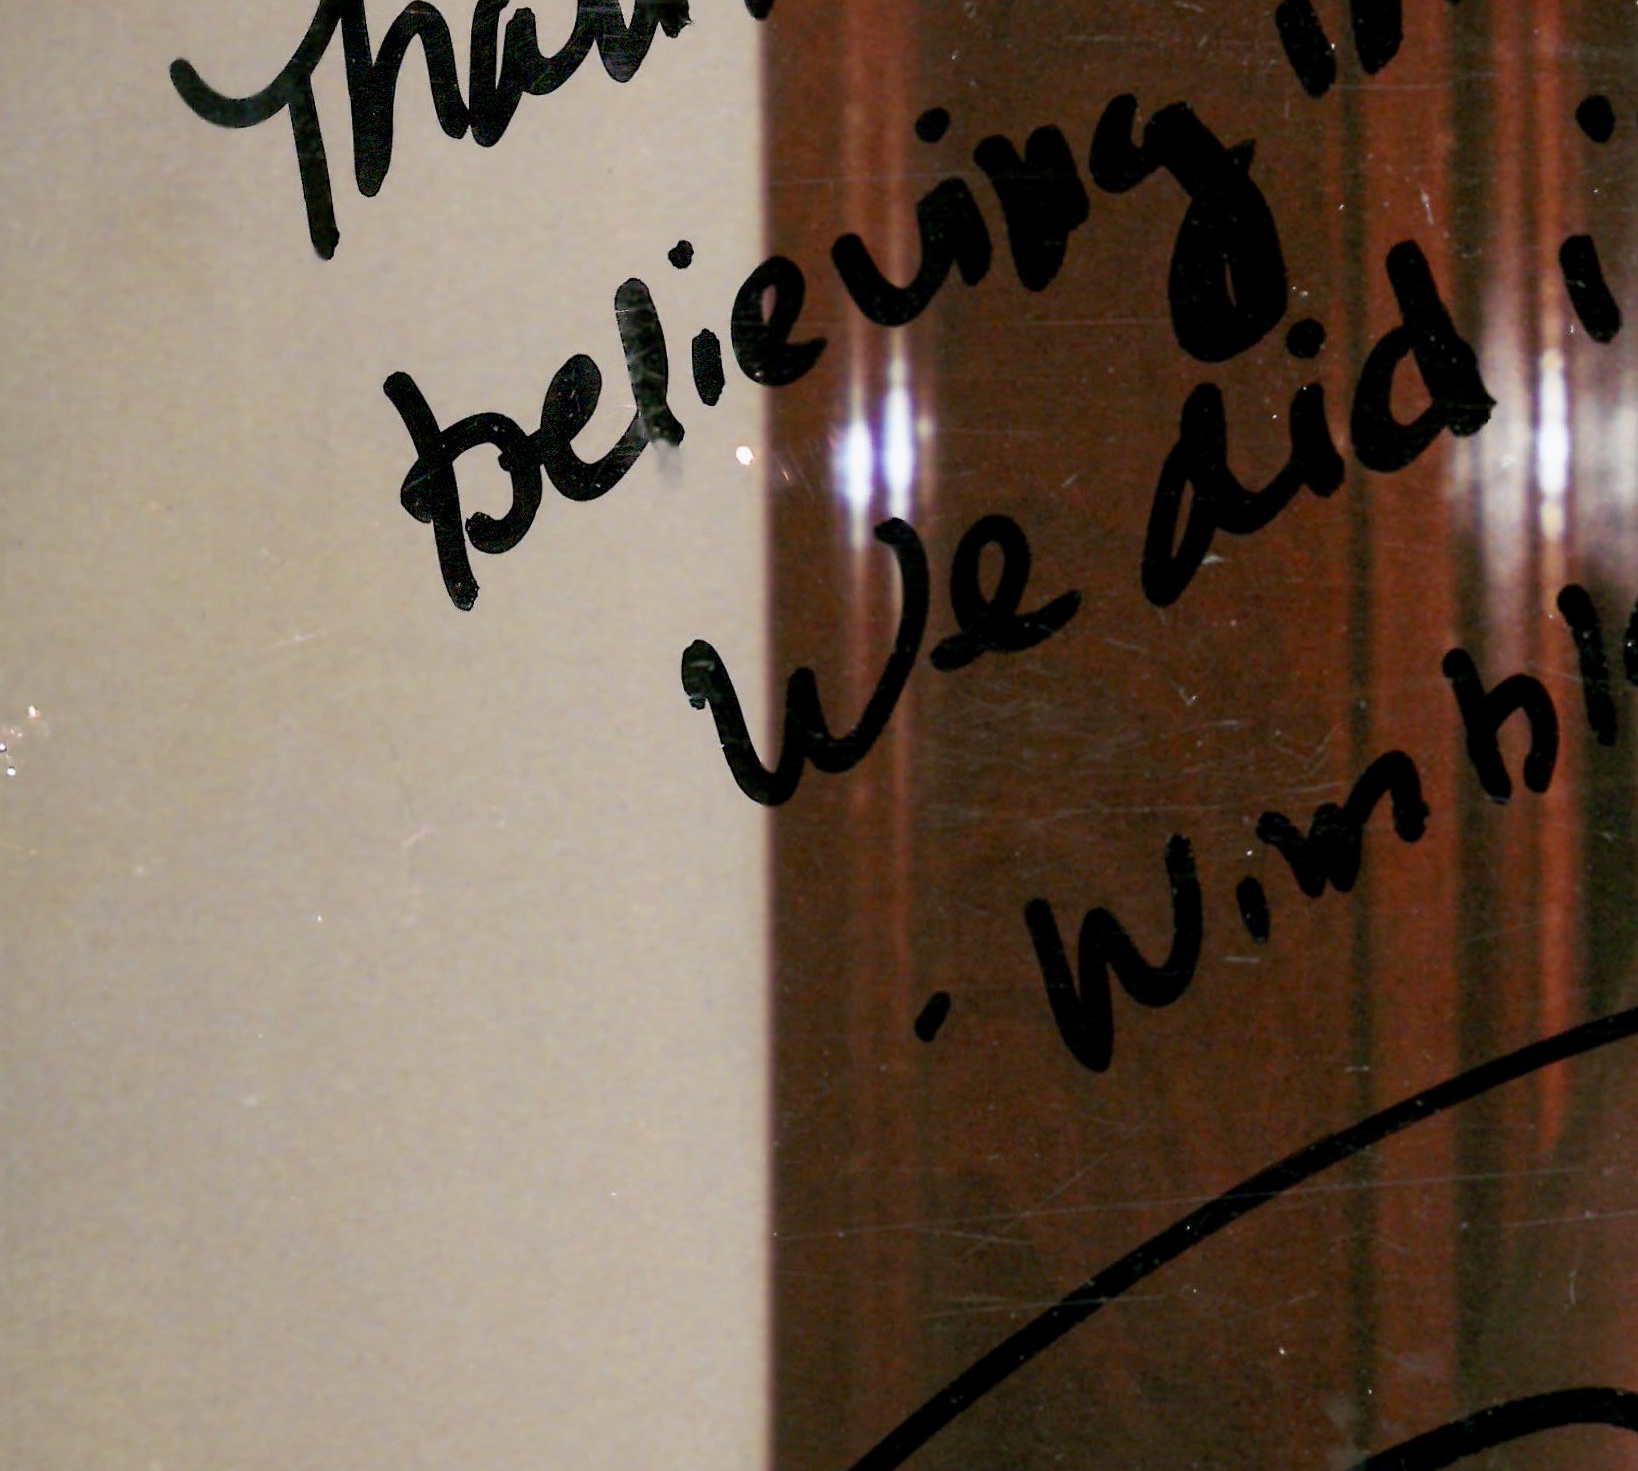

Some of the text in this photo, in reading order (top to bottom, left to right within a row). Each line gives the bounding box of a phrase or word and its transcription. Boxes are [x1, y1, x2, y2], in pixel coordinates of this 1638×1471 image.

[383, 102, 1289, 611] believing
[681, 514, 1083, 806] We
[1140, 238, 1497, 608] did
